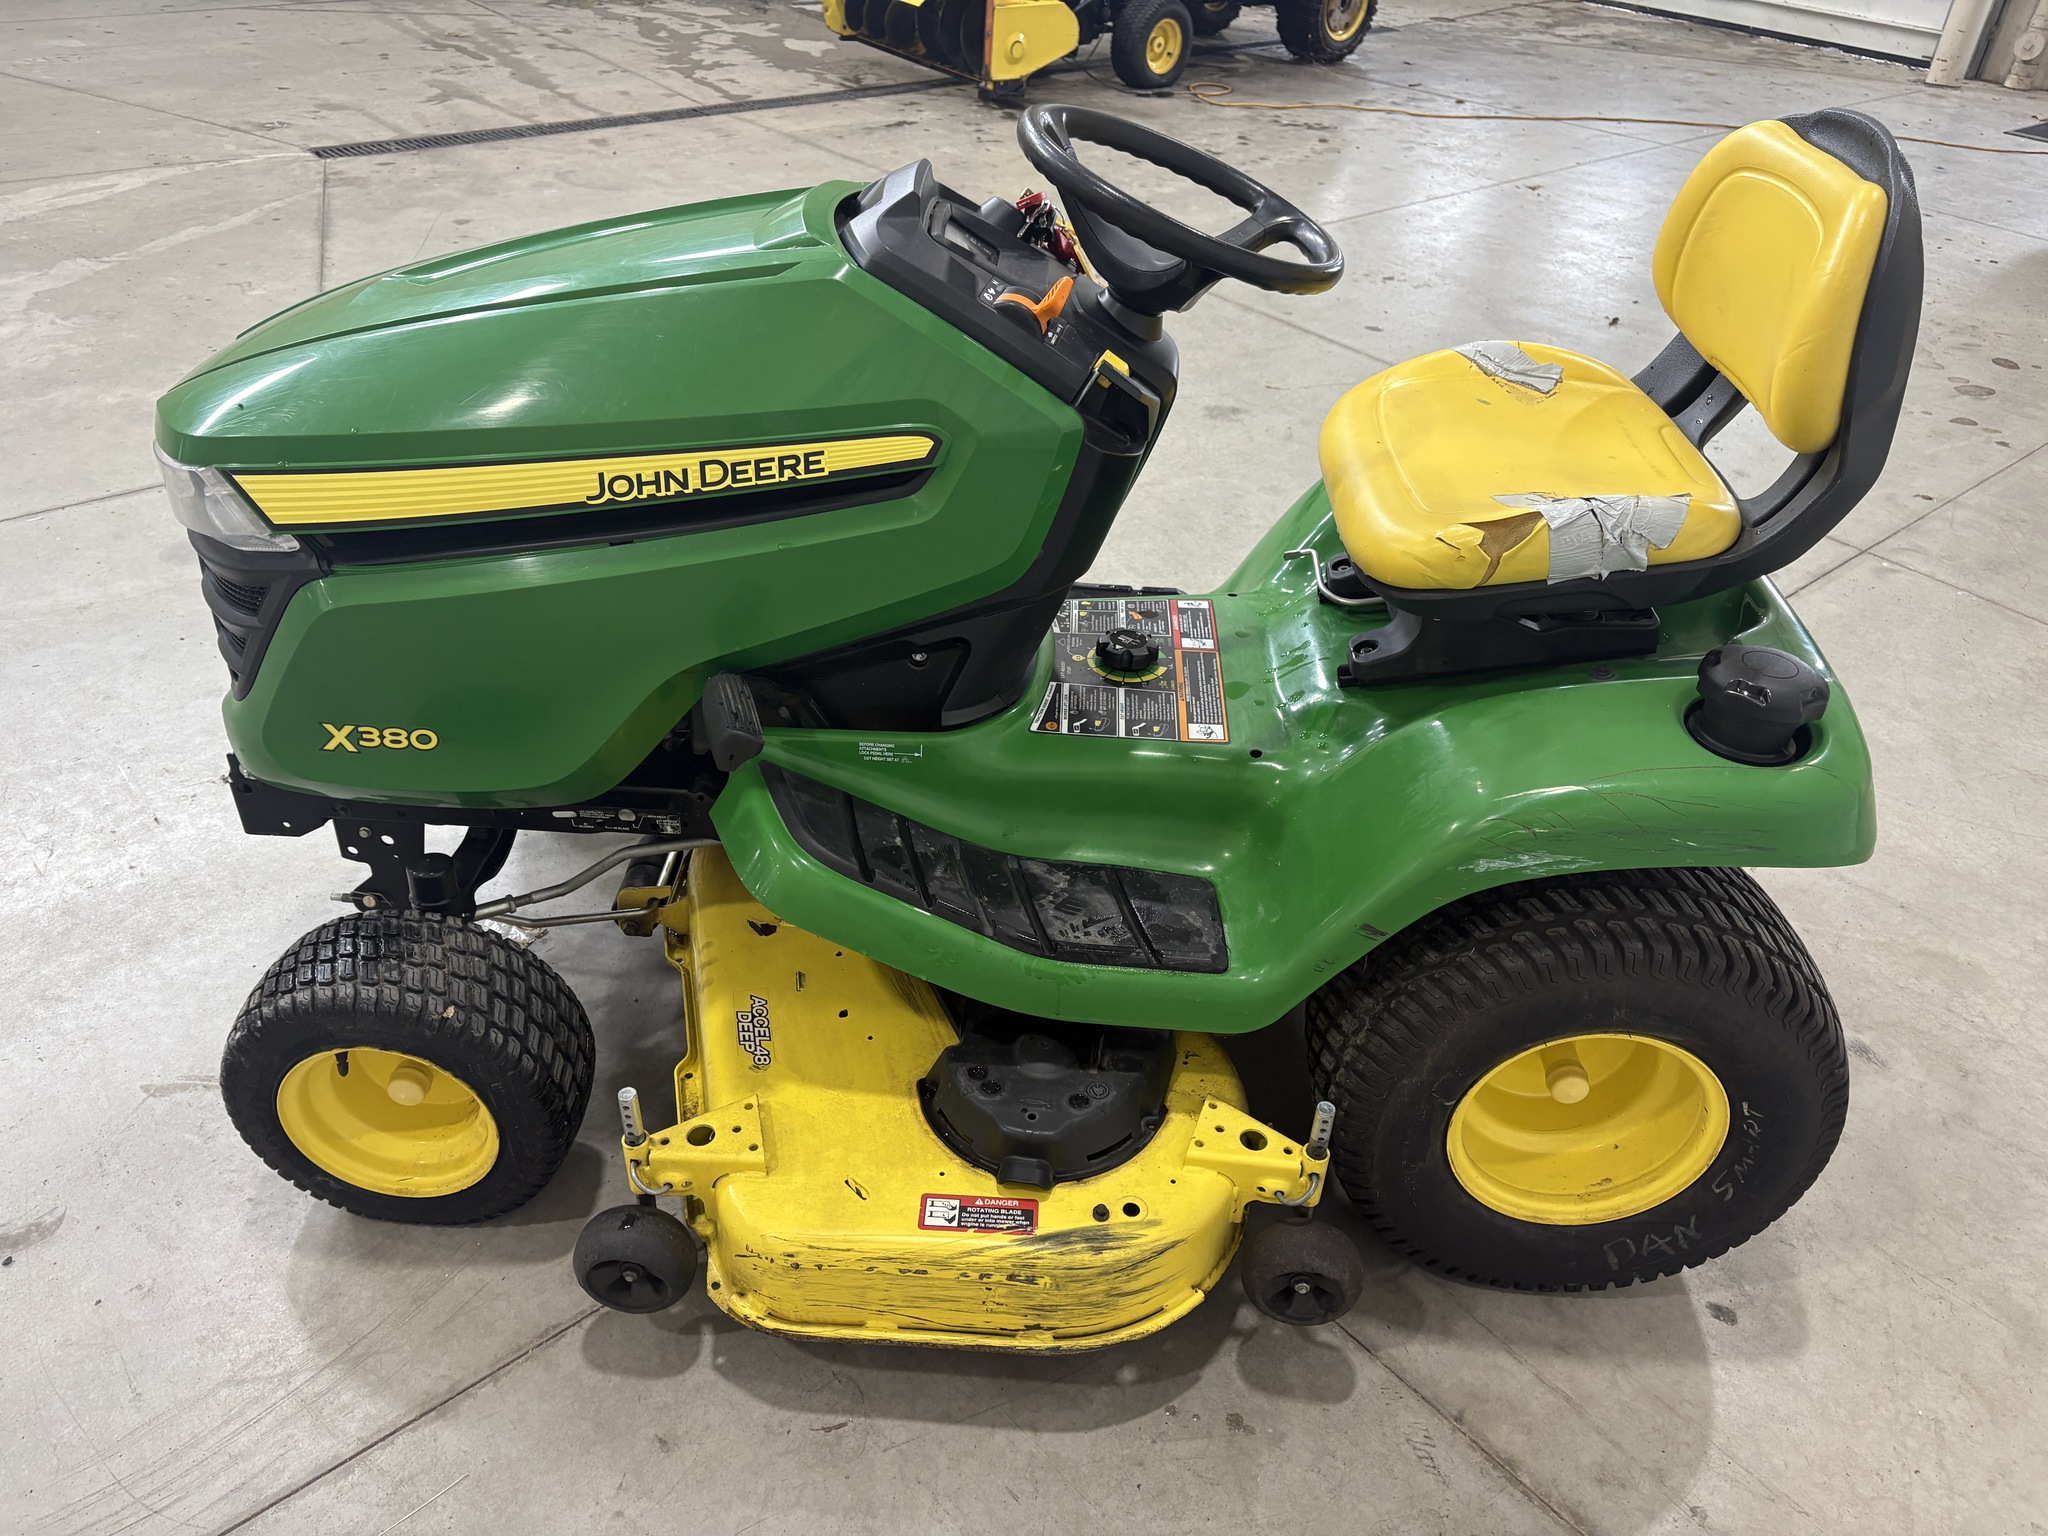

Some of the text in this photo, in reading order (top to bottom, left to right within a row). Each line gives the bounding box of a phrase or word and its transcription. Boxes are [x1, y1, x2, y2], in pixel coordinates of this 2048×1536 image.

[586, 449, 827, 502] JOHN DEERE
[319, 722, 439, 754] X380
[736, 1011, 756, 1055] DEEP
[984, 1199, 1019, 1207] DANGER
[1603, 1214, 1701, 1271] DAN
